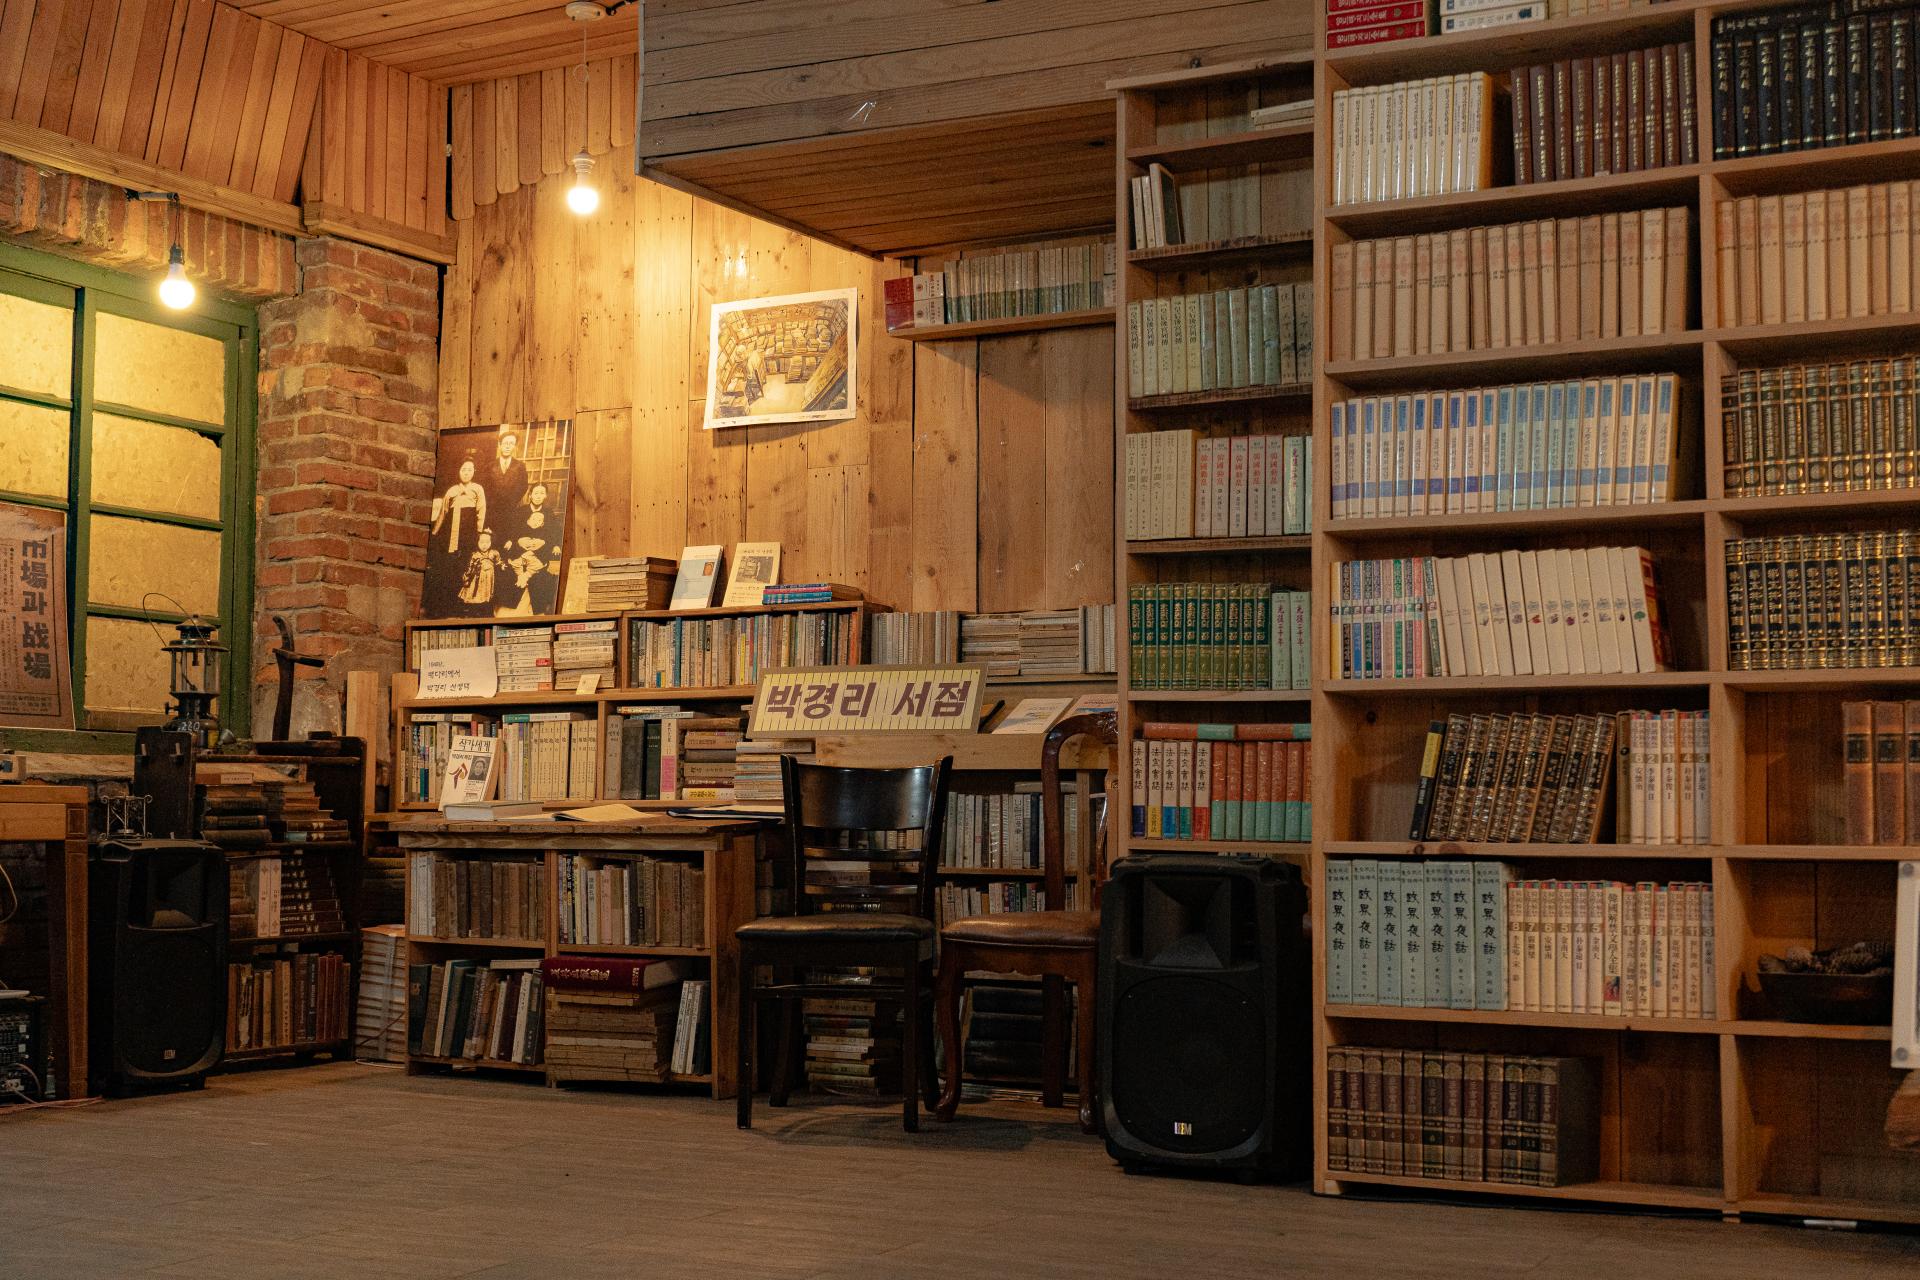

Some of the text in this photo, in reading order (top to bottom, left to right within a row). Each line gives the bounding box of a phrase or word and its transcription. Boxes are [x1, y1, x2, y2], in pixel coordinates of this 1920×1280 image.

[427, 683, 447, 692] 박경리
[767, 680, 972, 720] 박경리 서점
[459, 738, 491, 752] 작가세계
[1647, 754, 1656, 763] 2
[1664, 754, 1671, 762] 1
[1683, 753, 1691, 762] 4
[1699, 753, 1706, 762] 3
[1512, 922, 1520, 931] 8
[1527, 923, 1535, 932] 7
[1544, 923, 1553, 932] 6
[1560, 923, 1569, 933] 5
[1591, 923, 1600, 933] 5
[1639, 926, 1648, 936] 9
[1670, 927, 1683, 936] 12
[1707, 927, 1714, 936] 3
[1336, 1126, 1341, 1134] 1
[1352, 1128, 1359, 1137] 2
[1506, 1138, 1517, 1146] 10
[1525, 1140, 1535, 1148] 11
